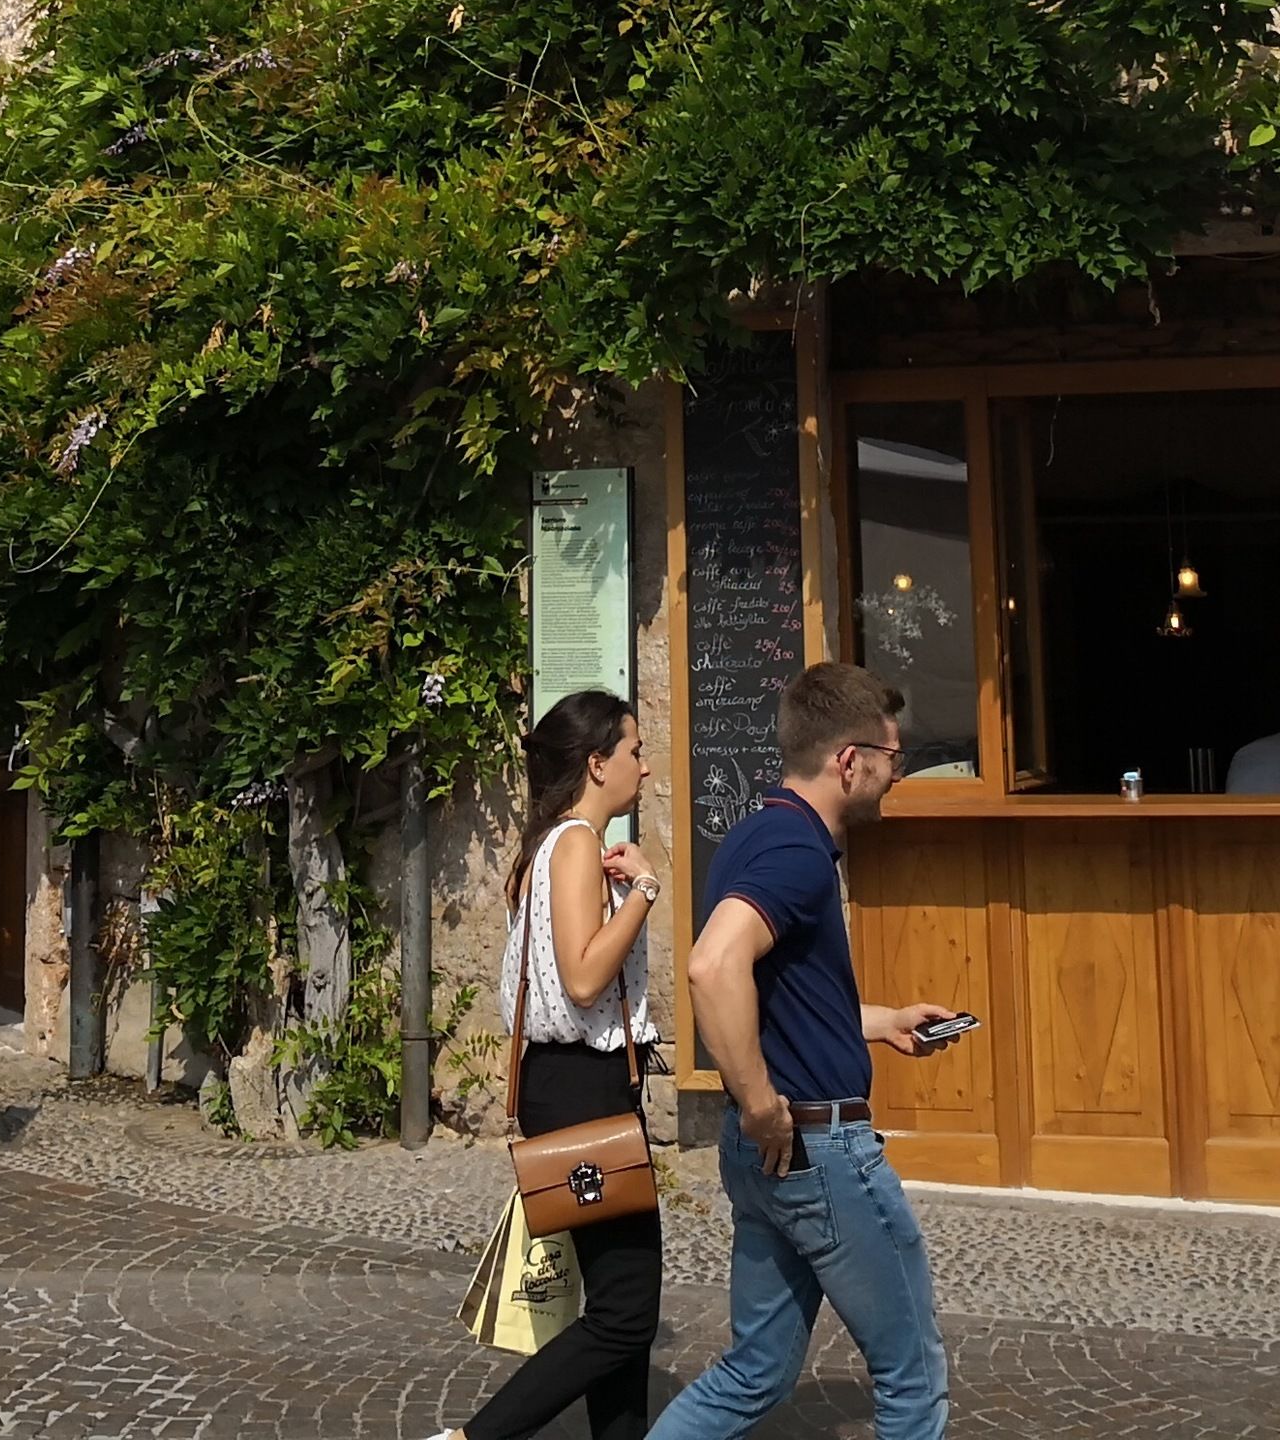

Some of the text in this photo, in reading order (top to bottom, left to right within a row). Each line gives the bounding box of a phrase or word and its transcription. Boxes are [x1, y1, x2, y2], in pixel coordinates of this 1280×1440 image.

[696, 632, 736, 656] caffè
[698, 674, 737, 697] caffè
[695, 693, 766, 711] americano
[694, 715, 732, 739] caffè
[526, 1240, 564, 1267] Casa
